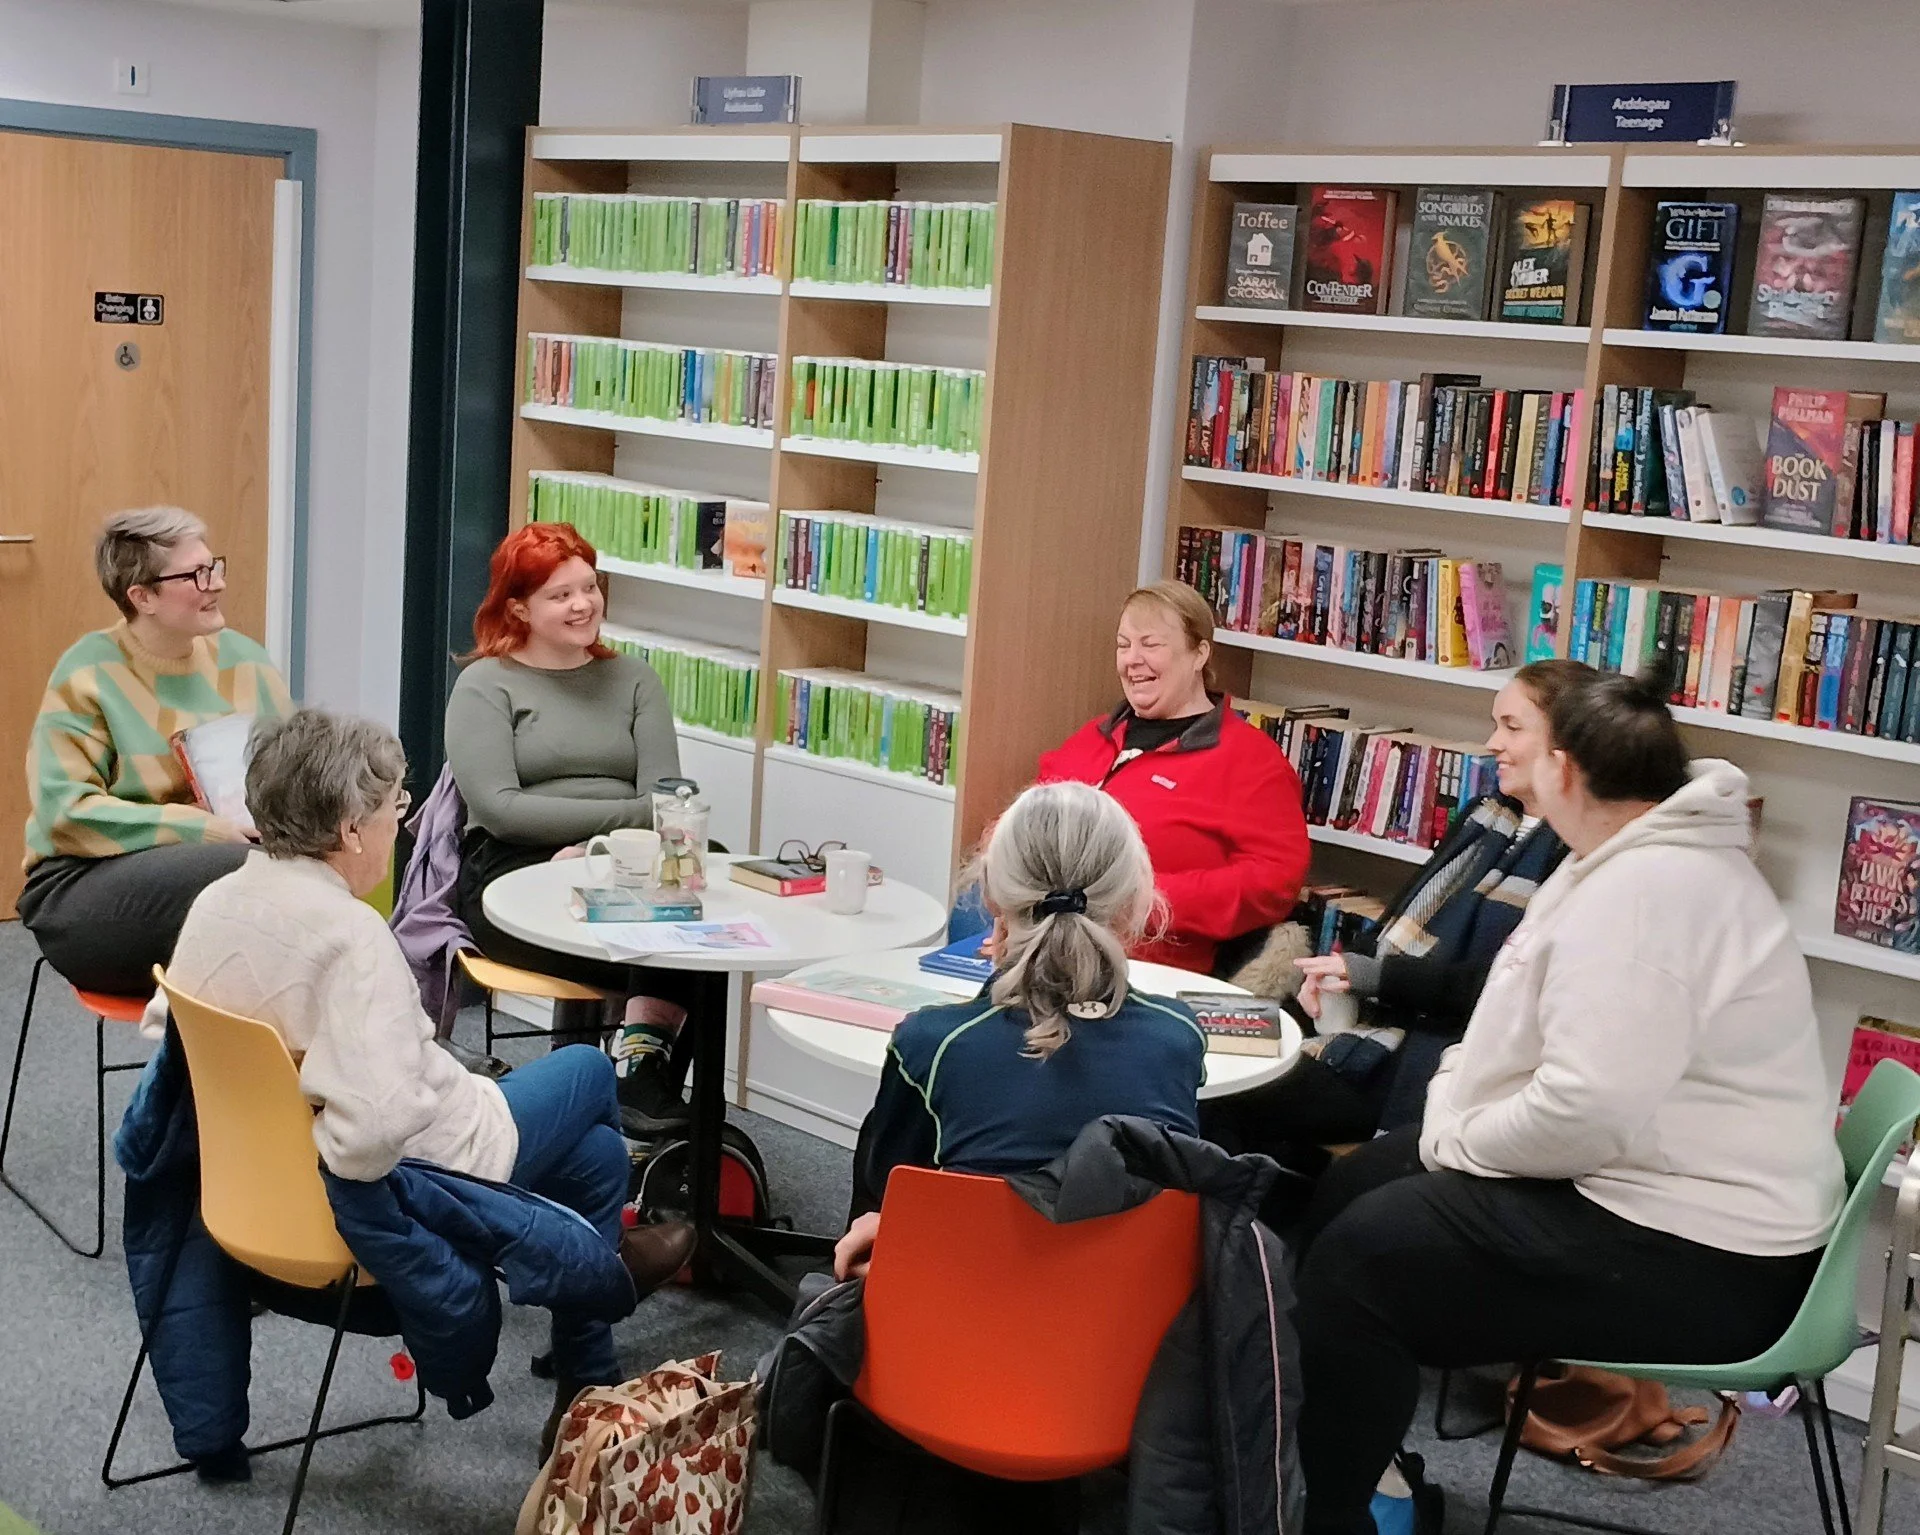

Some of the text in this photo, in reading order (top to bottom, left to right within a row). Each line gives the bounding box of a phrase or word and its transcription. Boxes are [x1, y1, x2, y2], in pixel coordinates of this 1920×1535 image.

[1418, 202, 1485, 215] SONGBIRDS
[1237, 211, 1289, 229] Toffee
[1438, 215, 1482, 228] SNAKES
[1665, 218, 1719, 240] GIFT
[1236, 276, 1277, 288] SARAH
[1306, 280, 1373, 298] CONTENDER
[1227, 286, 1285, 300] CROSSAN
[1787, 392, 1828, 408] PHILIP
[1772, 455, 1827, 480] BOOK
[1772, 477, 1822, 502] DUST
